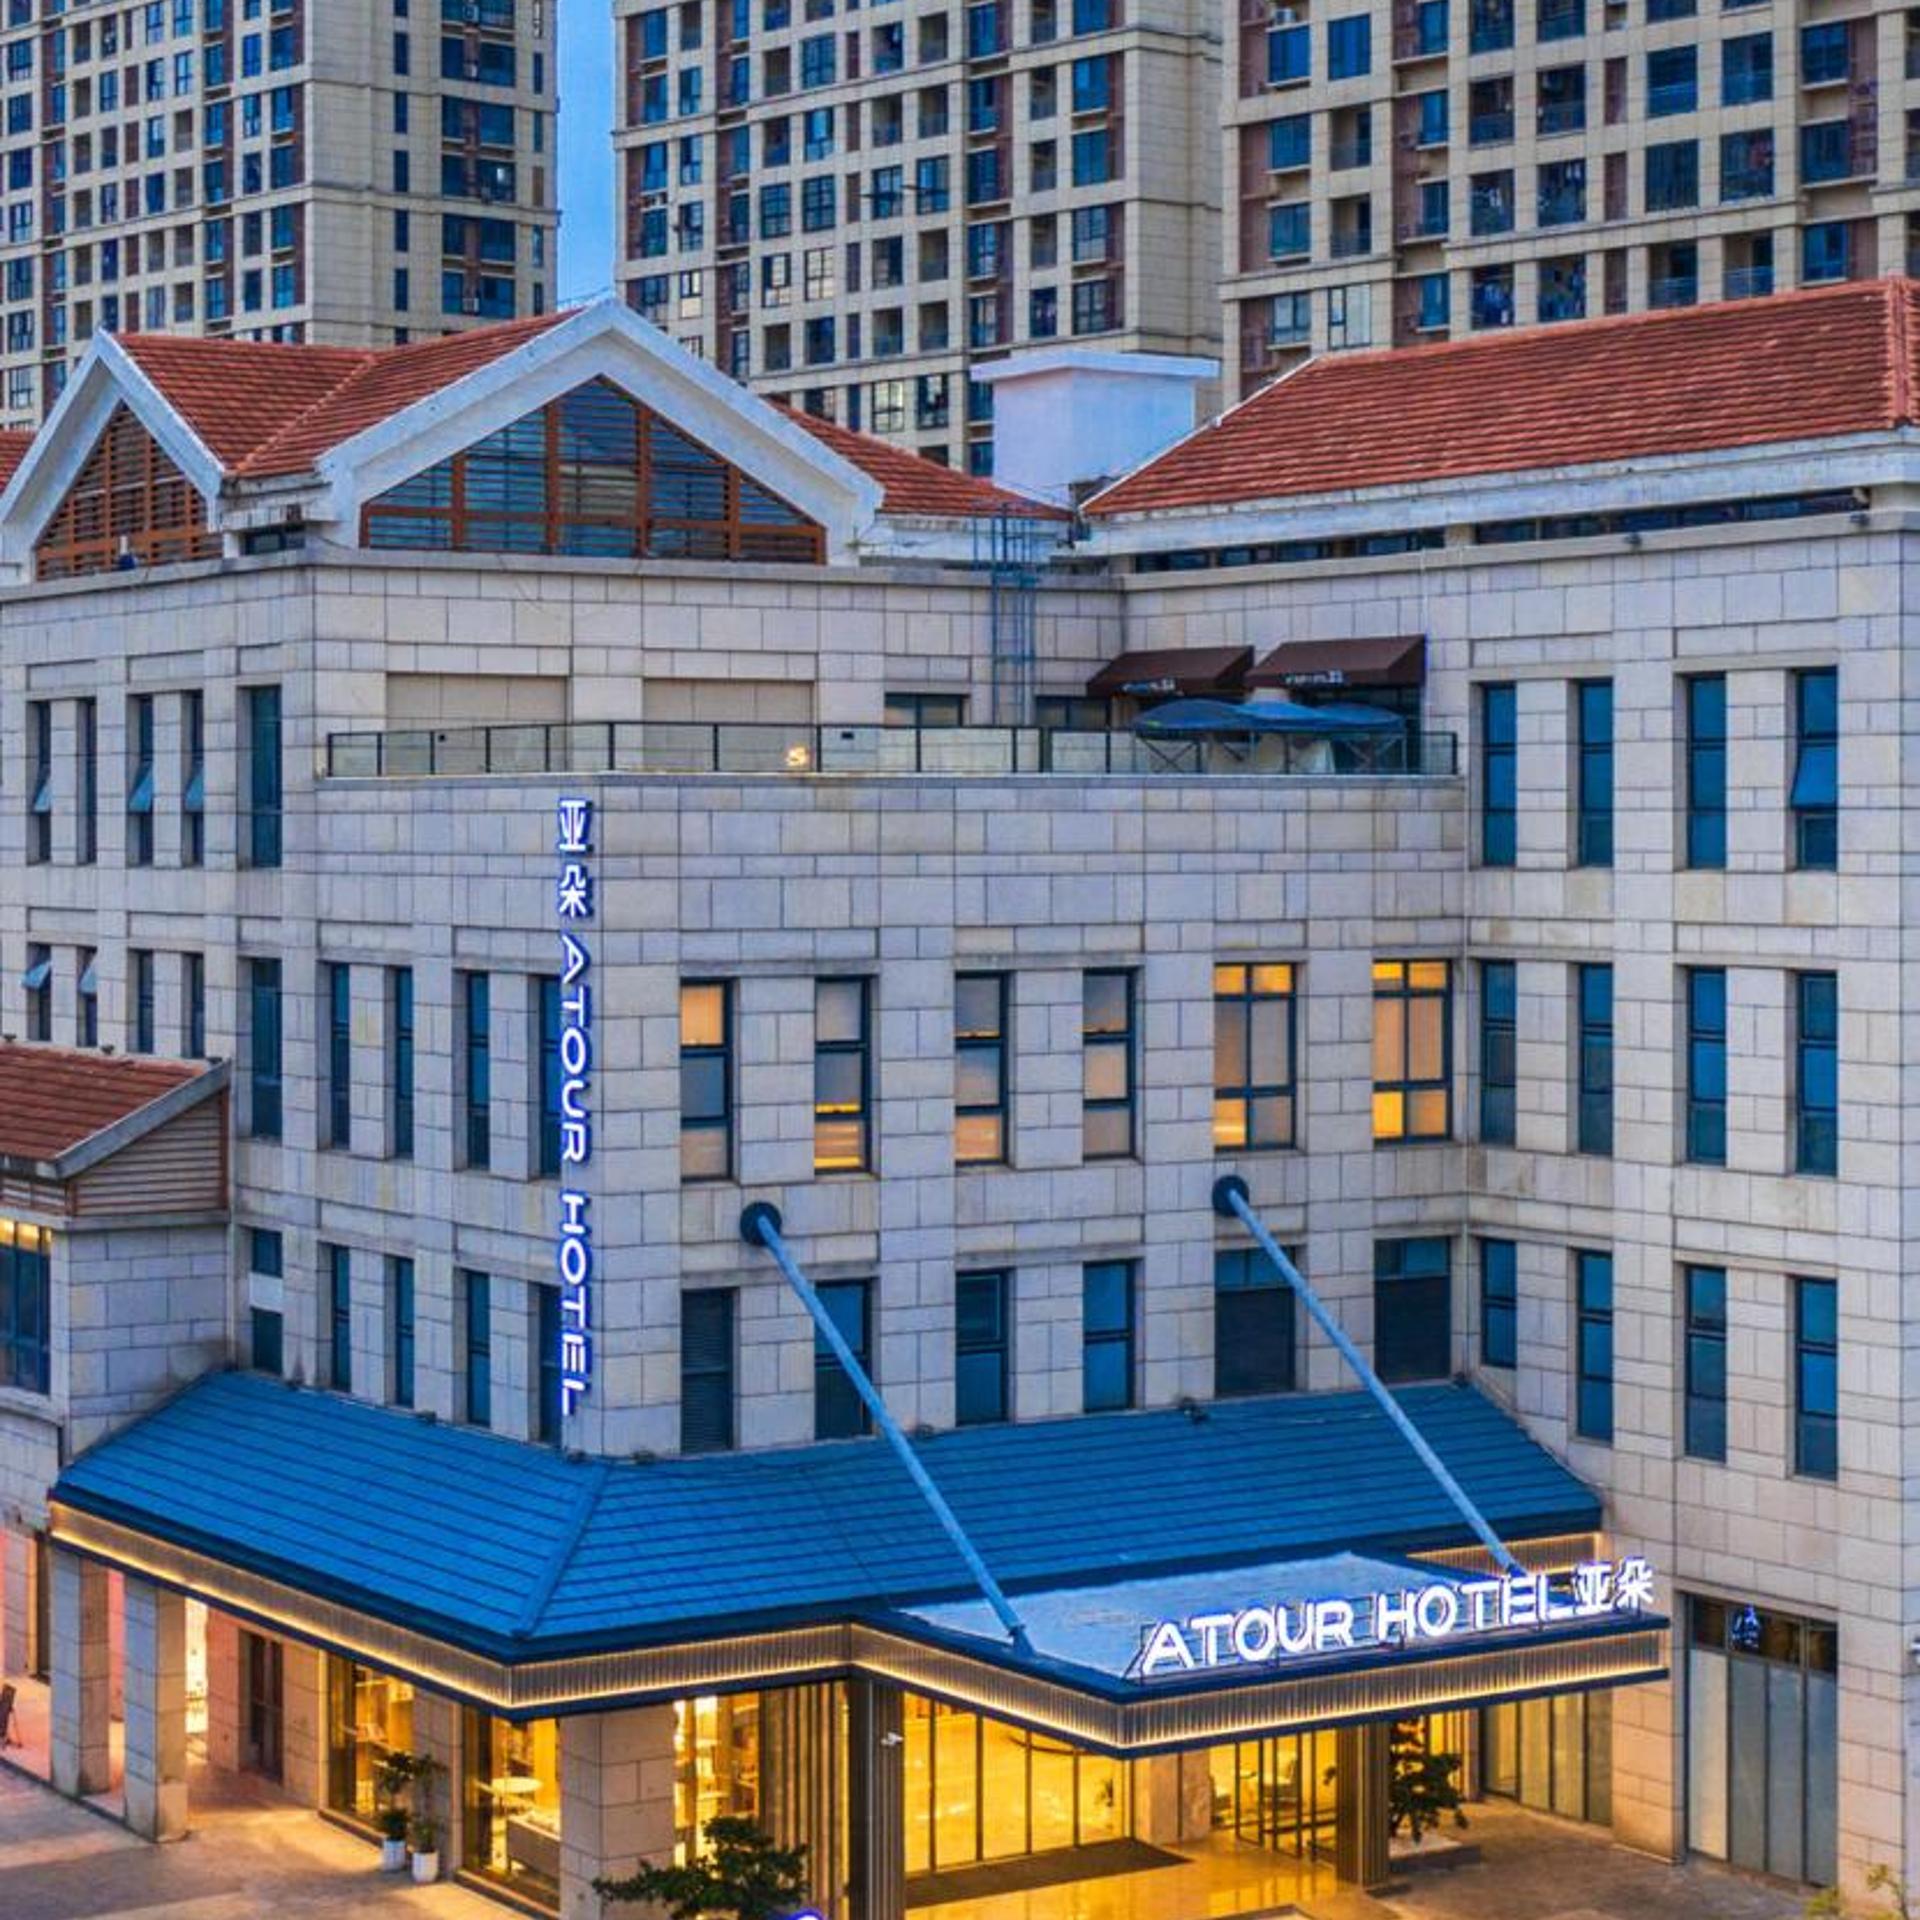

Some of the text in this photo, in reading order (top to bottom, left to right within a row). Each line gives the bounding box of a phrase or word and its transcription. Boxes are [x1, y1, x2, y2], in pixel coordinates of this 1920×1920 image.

[558, 799, 589, 1417] 亚朵 ATOUR HOTEL
[1141, 1557, 1654, 1675] ATOUR HOTEL 亚朵
